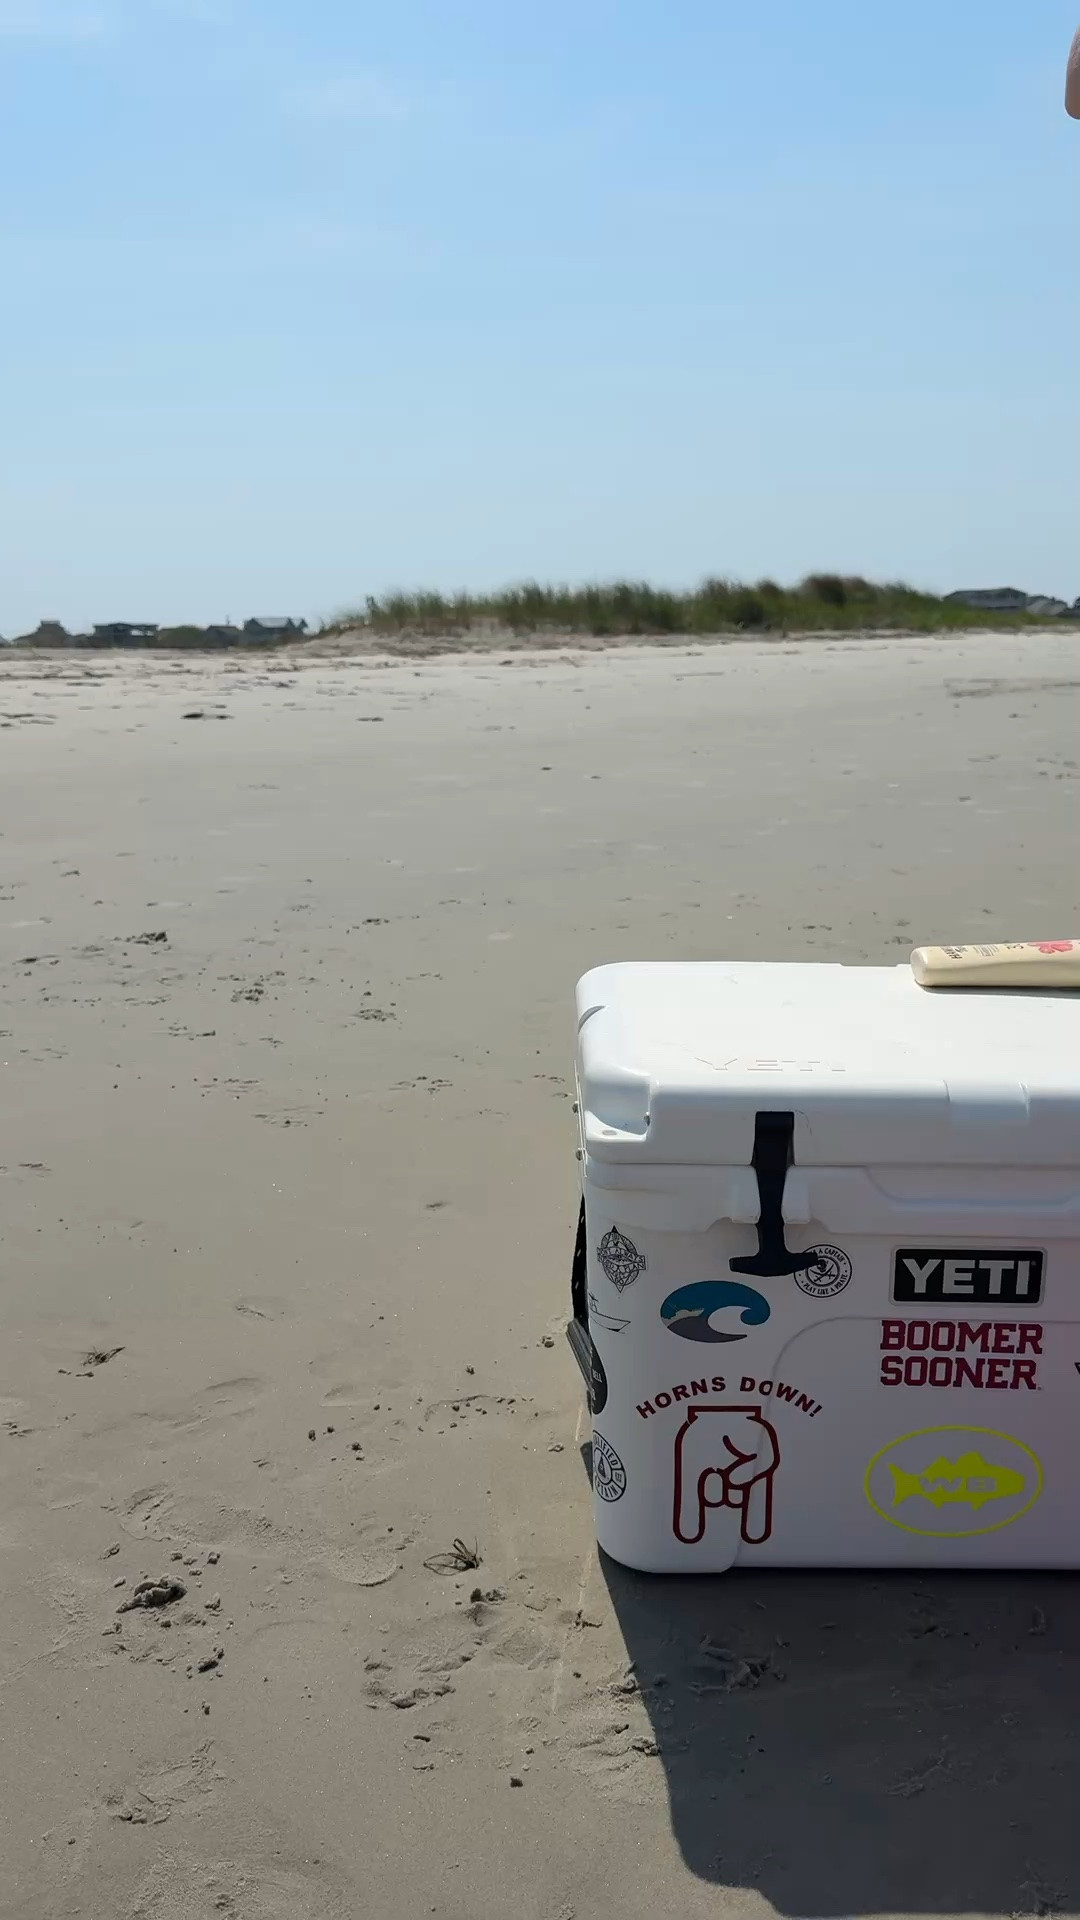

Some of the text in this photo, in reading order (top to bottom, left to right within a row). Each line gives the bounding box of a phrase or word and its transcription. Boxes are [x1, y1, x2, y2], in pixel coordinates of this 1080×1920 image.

[824, 1248, 846, 1263] CAPTAIN
[803, 1282, 816, 1294] PLAY
[834, 1274, 848, 1290] PIRATE
[902, 1258, 1030, 1295] YETI
[880, 1320, 1043, 1354] BOOMER
[880, 1355, 1037, 1389] SOONER
[636, 1376, 823, 1419] HORNS DOWN!
[919, 1476, 996, 1493] WB
